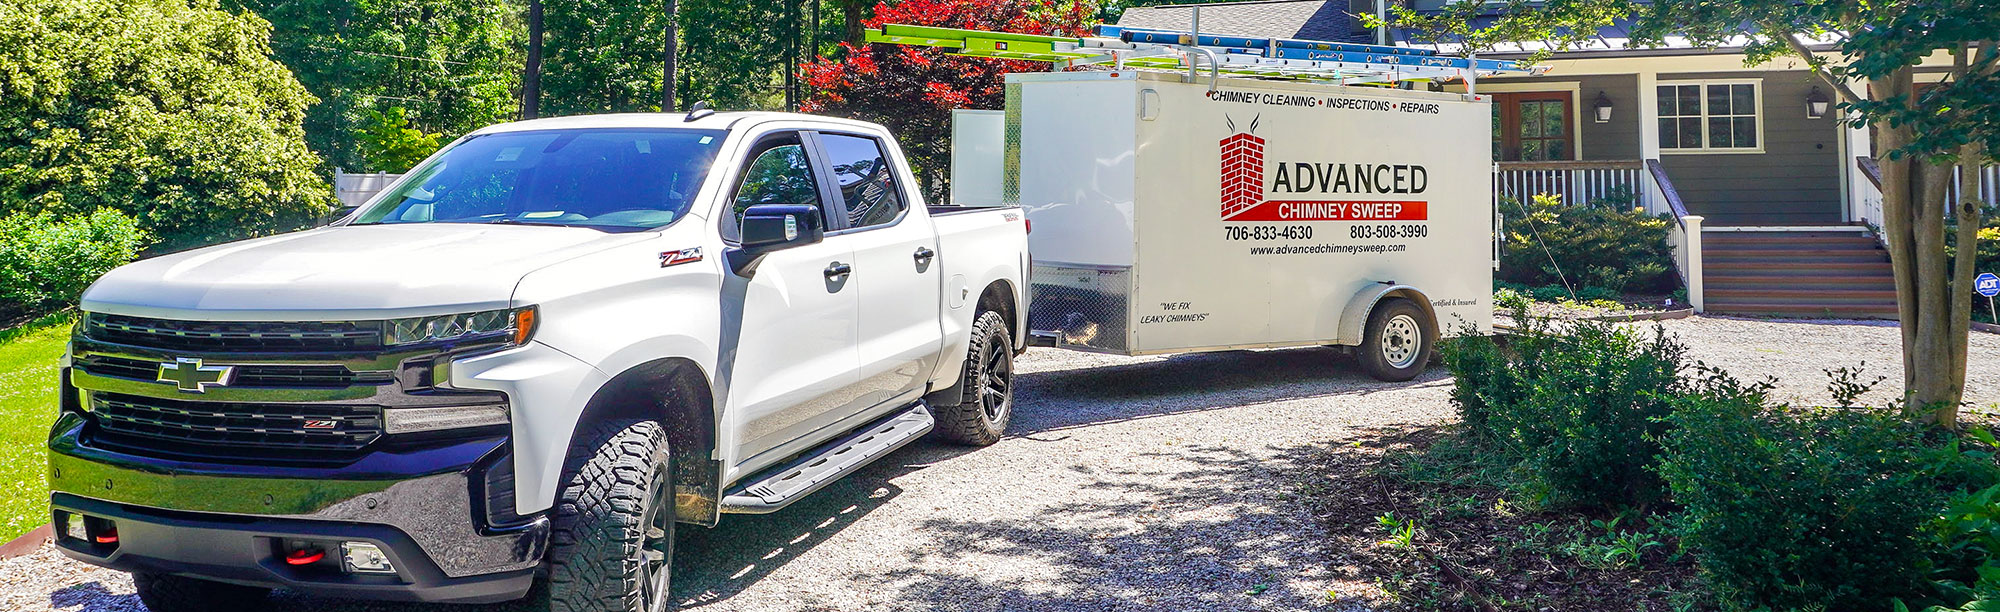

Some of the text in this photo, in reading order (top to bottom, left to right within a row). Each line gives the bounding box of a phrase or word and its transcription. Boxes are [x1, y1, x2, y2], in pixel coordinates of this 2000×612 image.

[1211, 90, 1440, 115] CHIMNEY CLEANING INSPECTIONS REPAIRS
[1271, 162, 1428, 195] ADVANCED
[1278, 202, 1402, 219] CHIMNEY SWEEP
[1224, 225, 1313, 241] 706-833-4630
[1350, 224, 1428, 239] 803-508-3990
[658, 246, 703, 268] Z71
[1250, 243, 1406, 256] www.advancedchimneysweep.com
[1979, 279, 1998, 289] ADT
[1178, 302, 1191, 310] FIX
[1458, 298, 1477, 306] Insured
[1140, 315, 1166, 324] LEAKY
